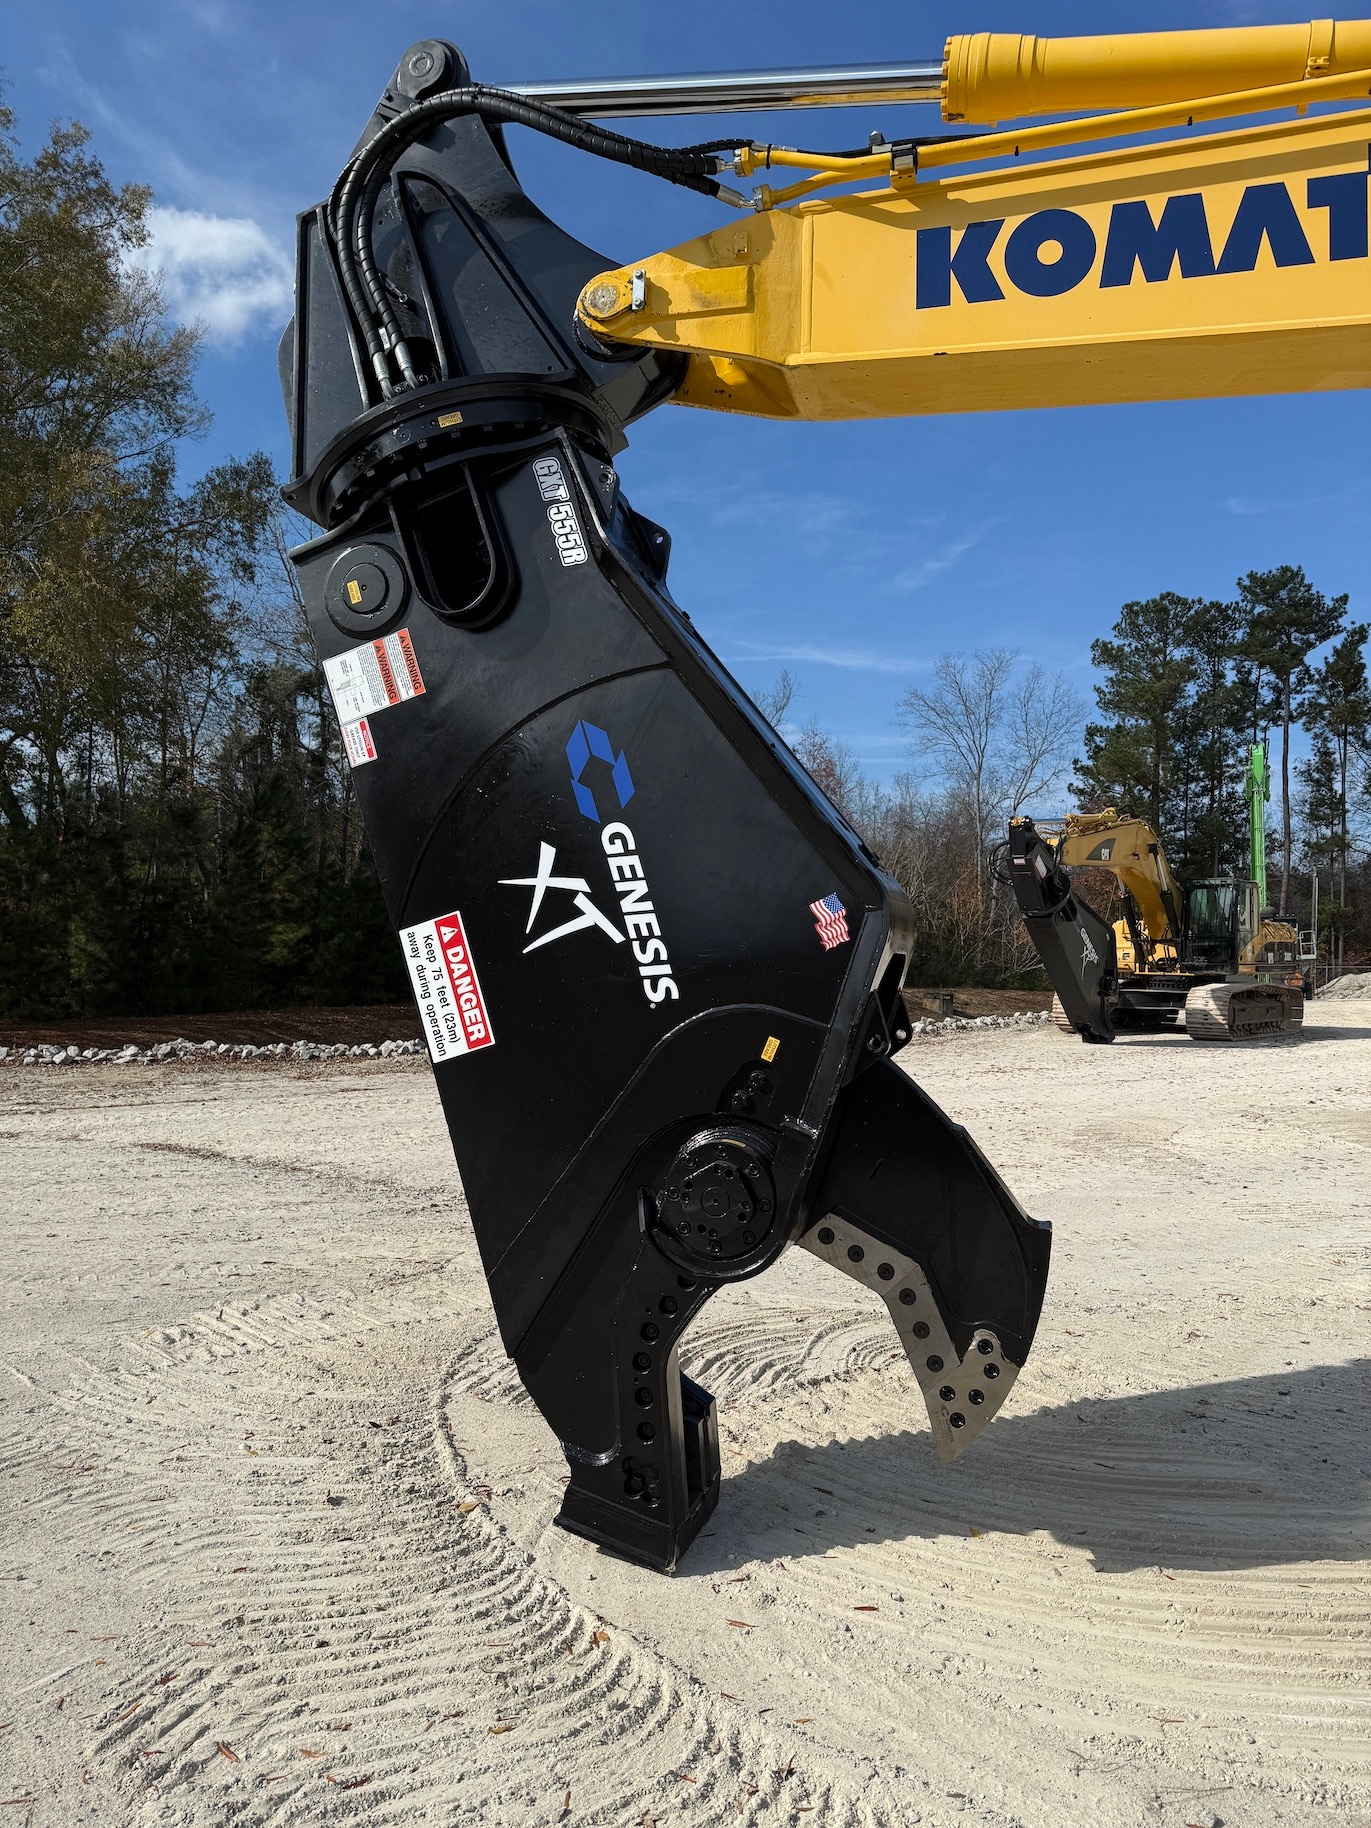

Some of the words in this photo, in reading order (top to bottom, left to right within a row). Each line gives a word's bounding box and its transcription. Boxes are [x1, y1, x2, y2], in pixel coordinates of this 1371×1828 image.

[533, 456, 570, 501] GXT
[547, 501, 588, 567] 555R
[378, 653, 397, 699] WARNING
[402, 643, 421, 690] WARNING
[362, 729, 371, 749] NOTICE
[423, 934, 437, 963] Keep
[1080, 927, 1099, 964] GENESIS
[407, 932, 420, 959] away
[416, 964, 432, 1000] during
[425, 1003, 446, 1057] operation
[432, 967, 443, 981] 75
[446, 945, 486, 1042] DANGER
[437, 985, 450, 1008] feet
[442, 1012, 461, 1044] (23m)
